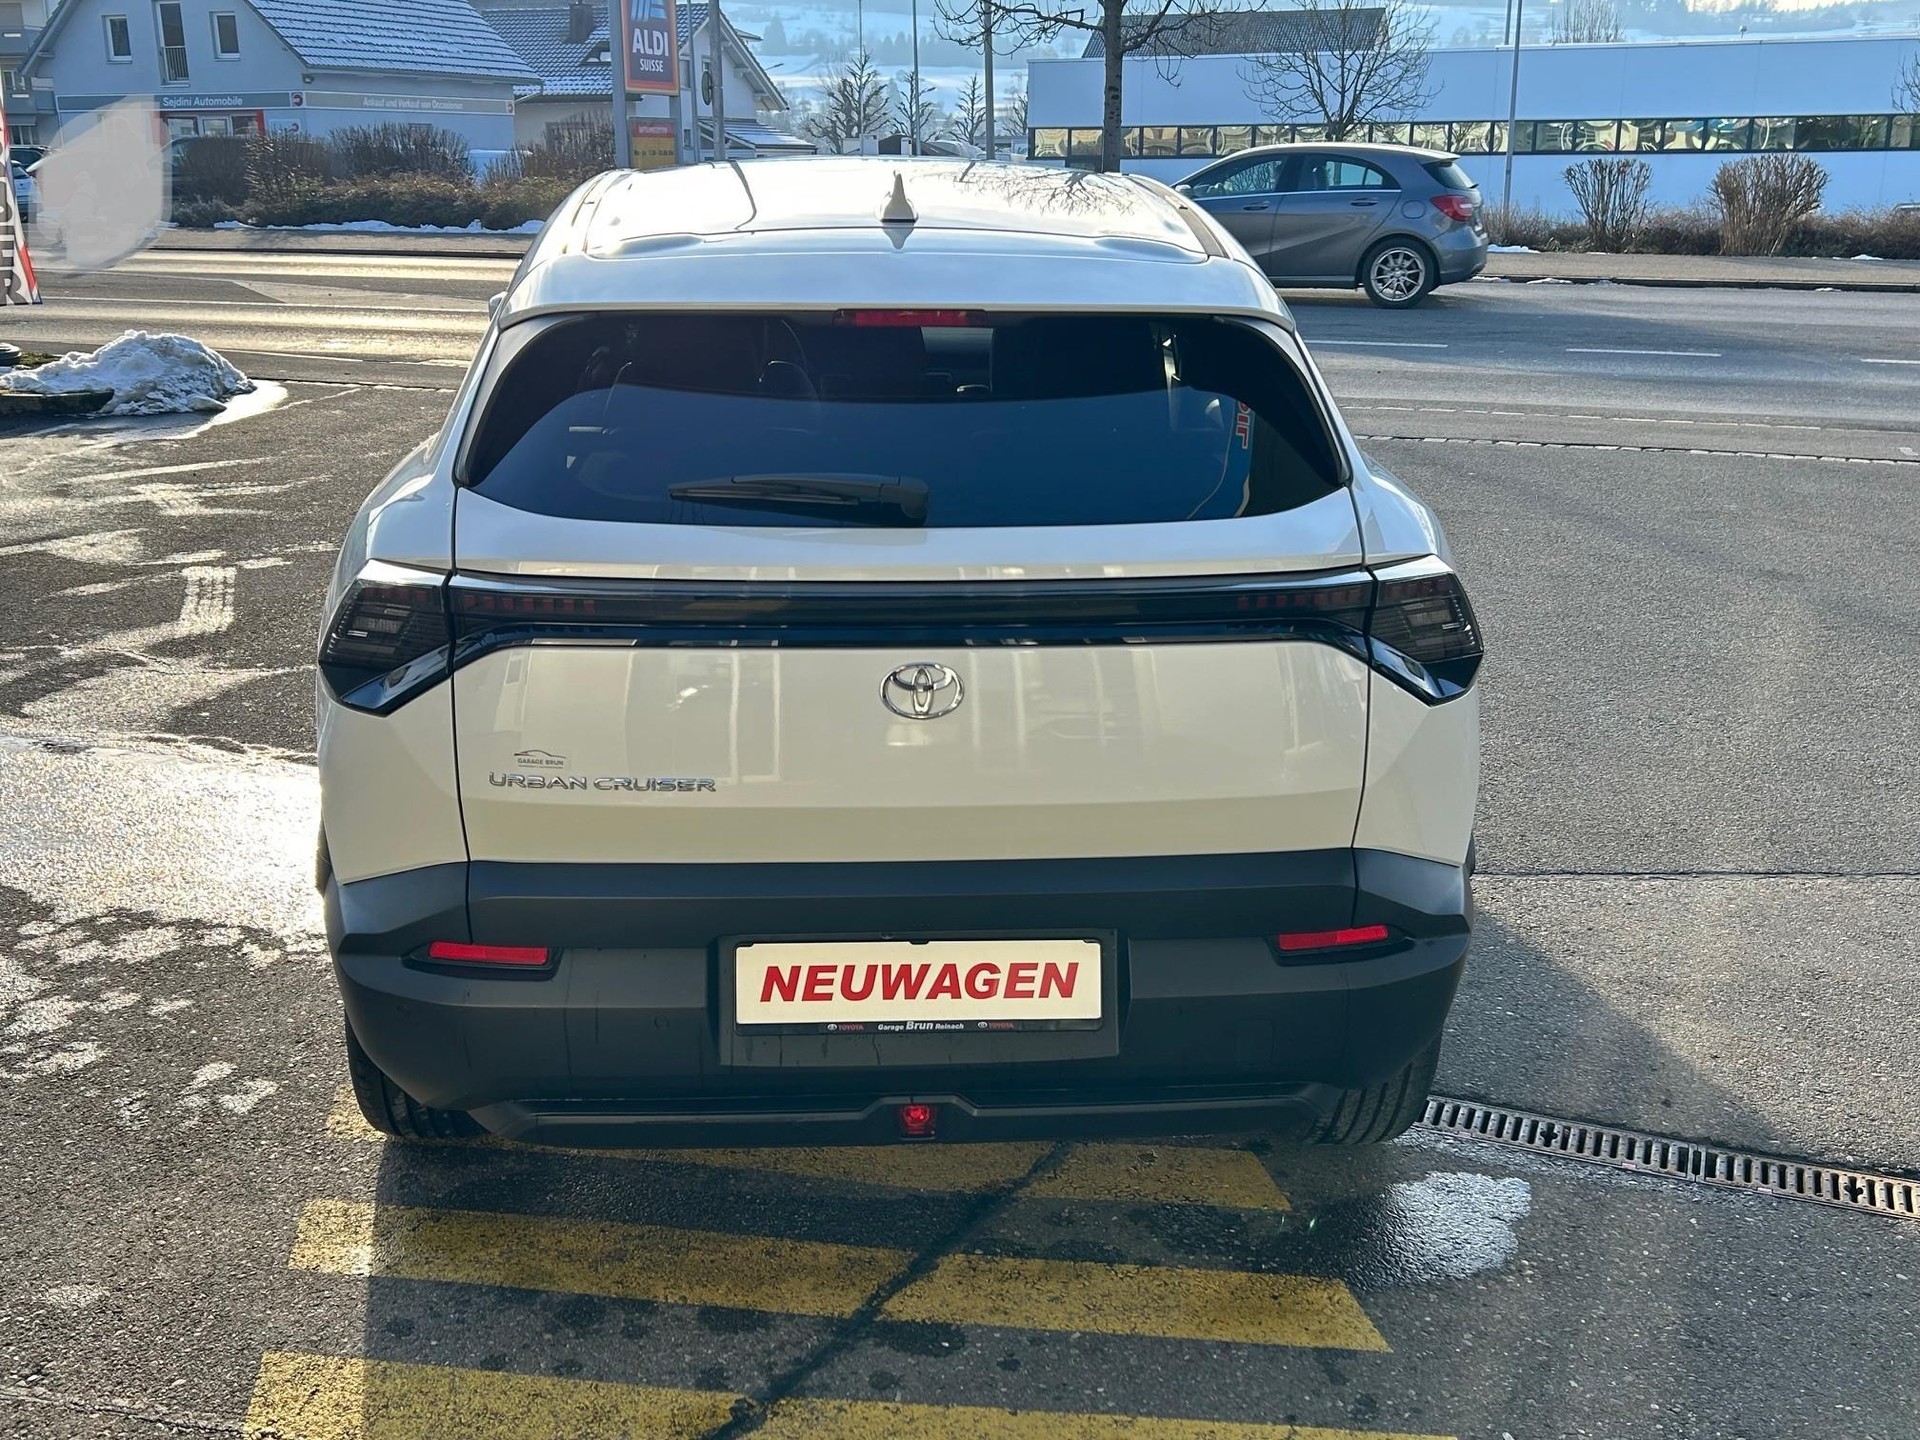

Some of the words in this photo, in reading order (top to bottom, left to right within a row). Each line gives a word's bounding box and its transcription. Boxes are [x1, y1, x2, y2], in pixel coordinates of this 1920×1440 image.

[632, 28, 669, 56] ALDI
[640, 58, 664, 72] SUISSE
[162, 97, 192, 107] Sejdini
[193, 97, 243, 106] Automobile
[489, 772, 588, 790] URBAN
[593, 777, 717, 792] CRUISER
[760, 962, 1079, 1003] NEUWAGEN
[878, 1023, 904, 1031] Garage
[905, 1020, 934, 1031] Brun
[935, 1022, 965, 1031] Reinach
